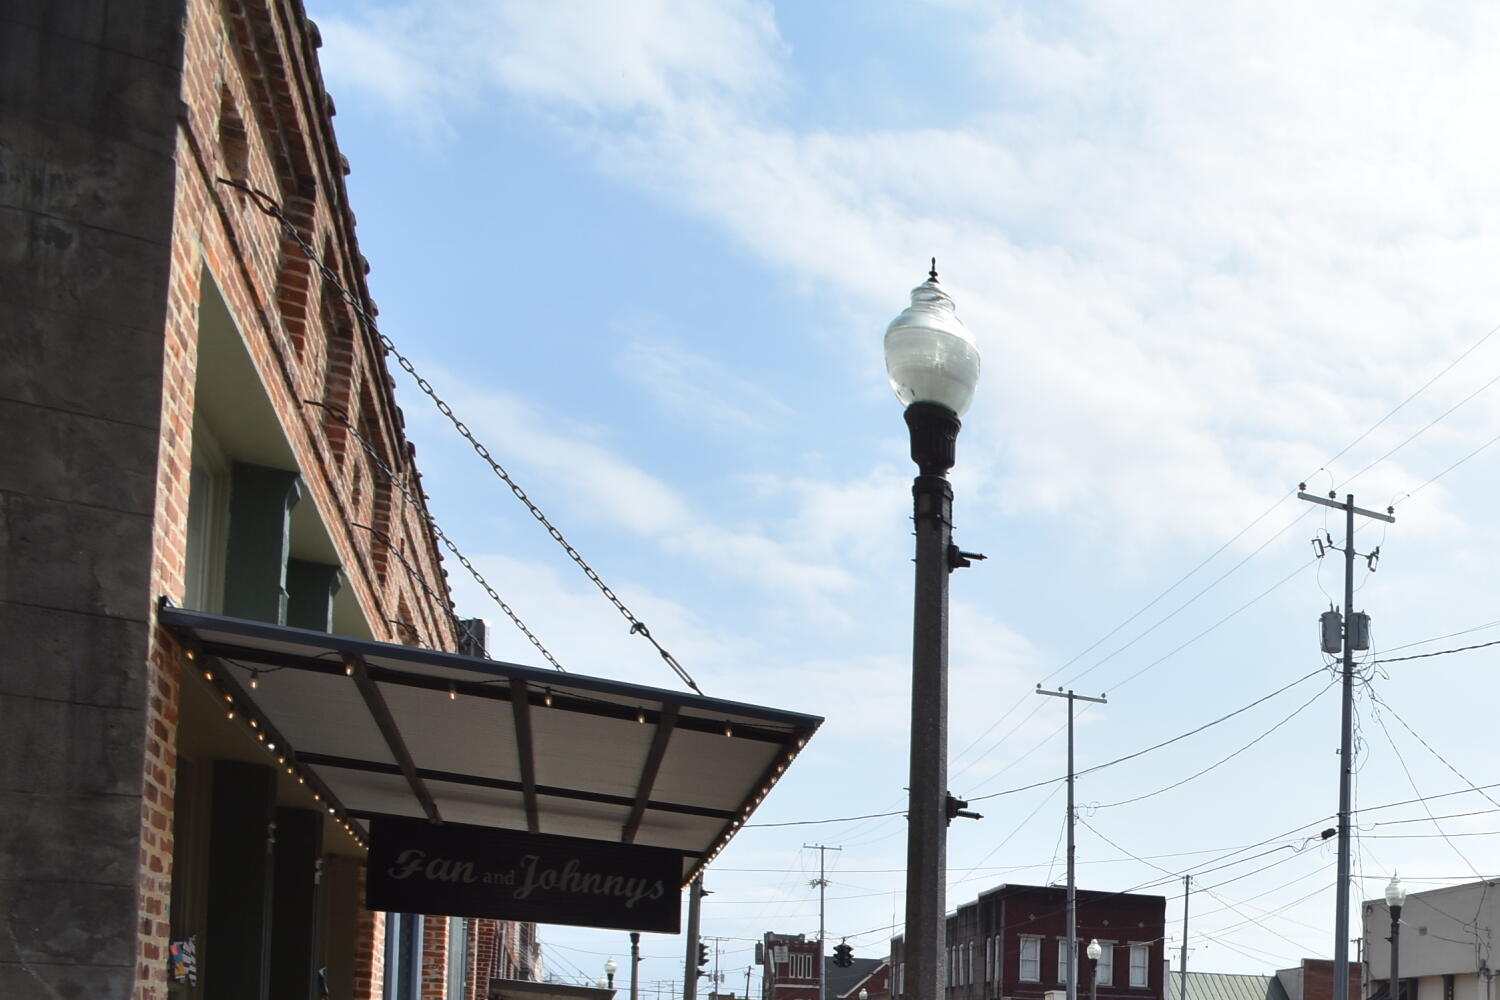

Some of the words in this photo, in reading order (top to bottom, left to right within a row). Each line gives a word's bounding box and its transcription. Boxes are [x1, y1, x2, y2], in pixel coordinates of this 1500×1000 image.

[388, 850, 478, 884] Fan
[483, 870, 515, 885] and
[513, 855, 665, 908] Johnnys
